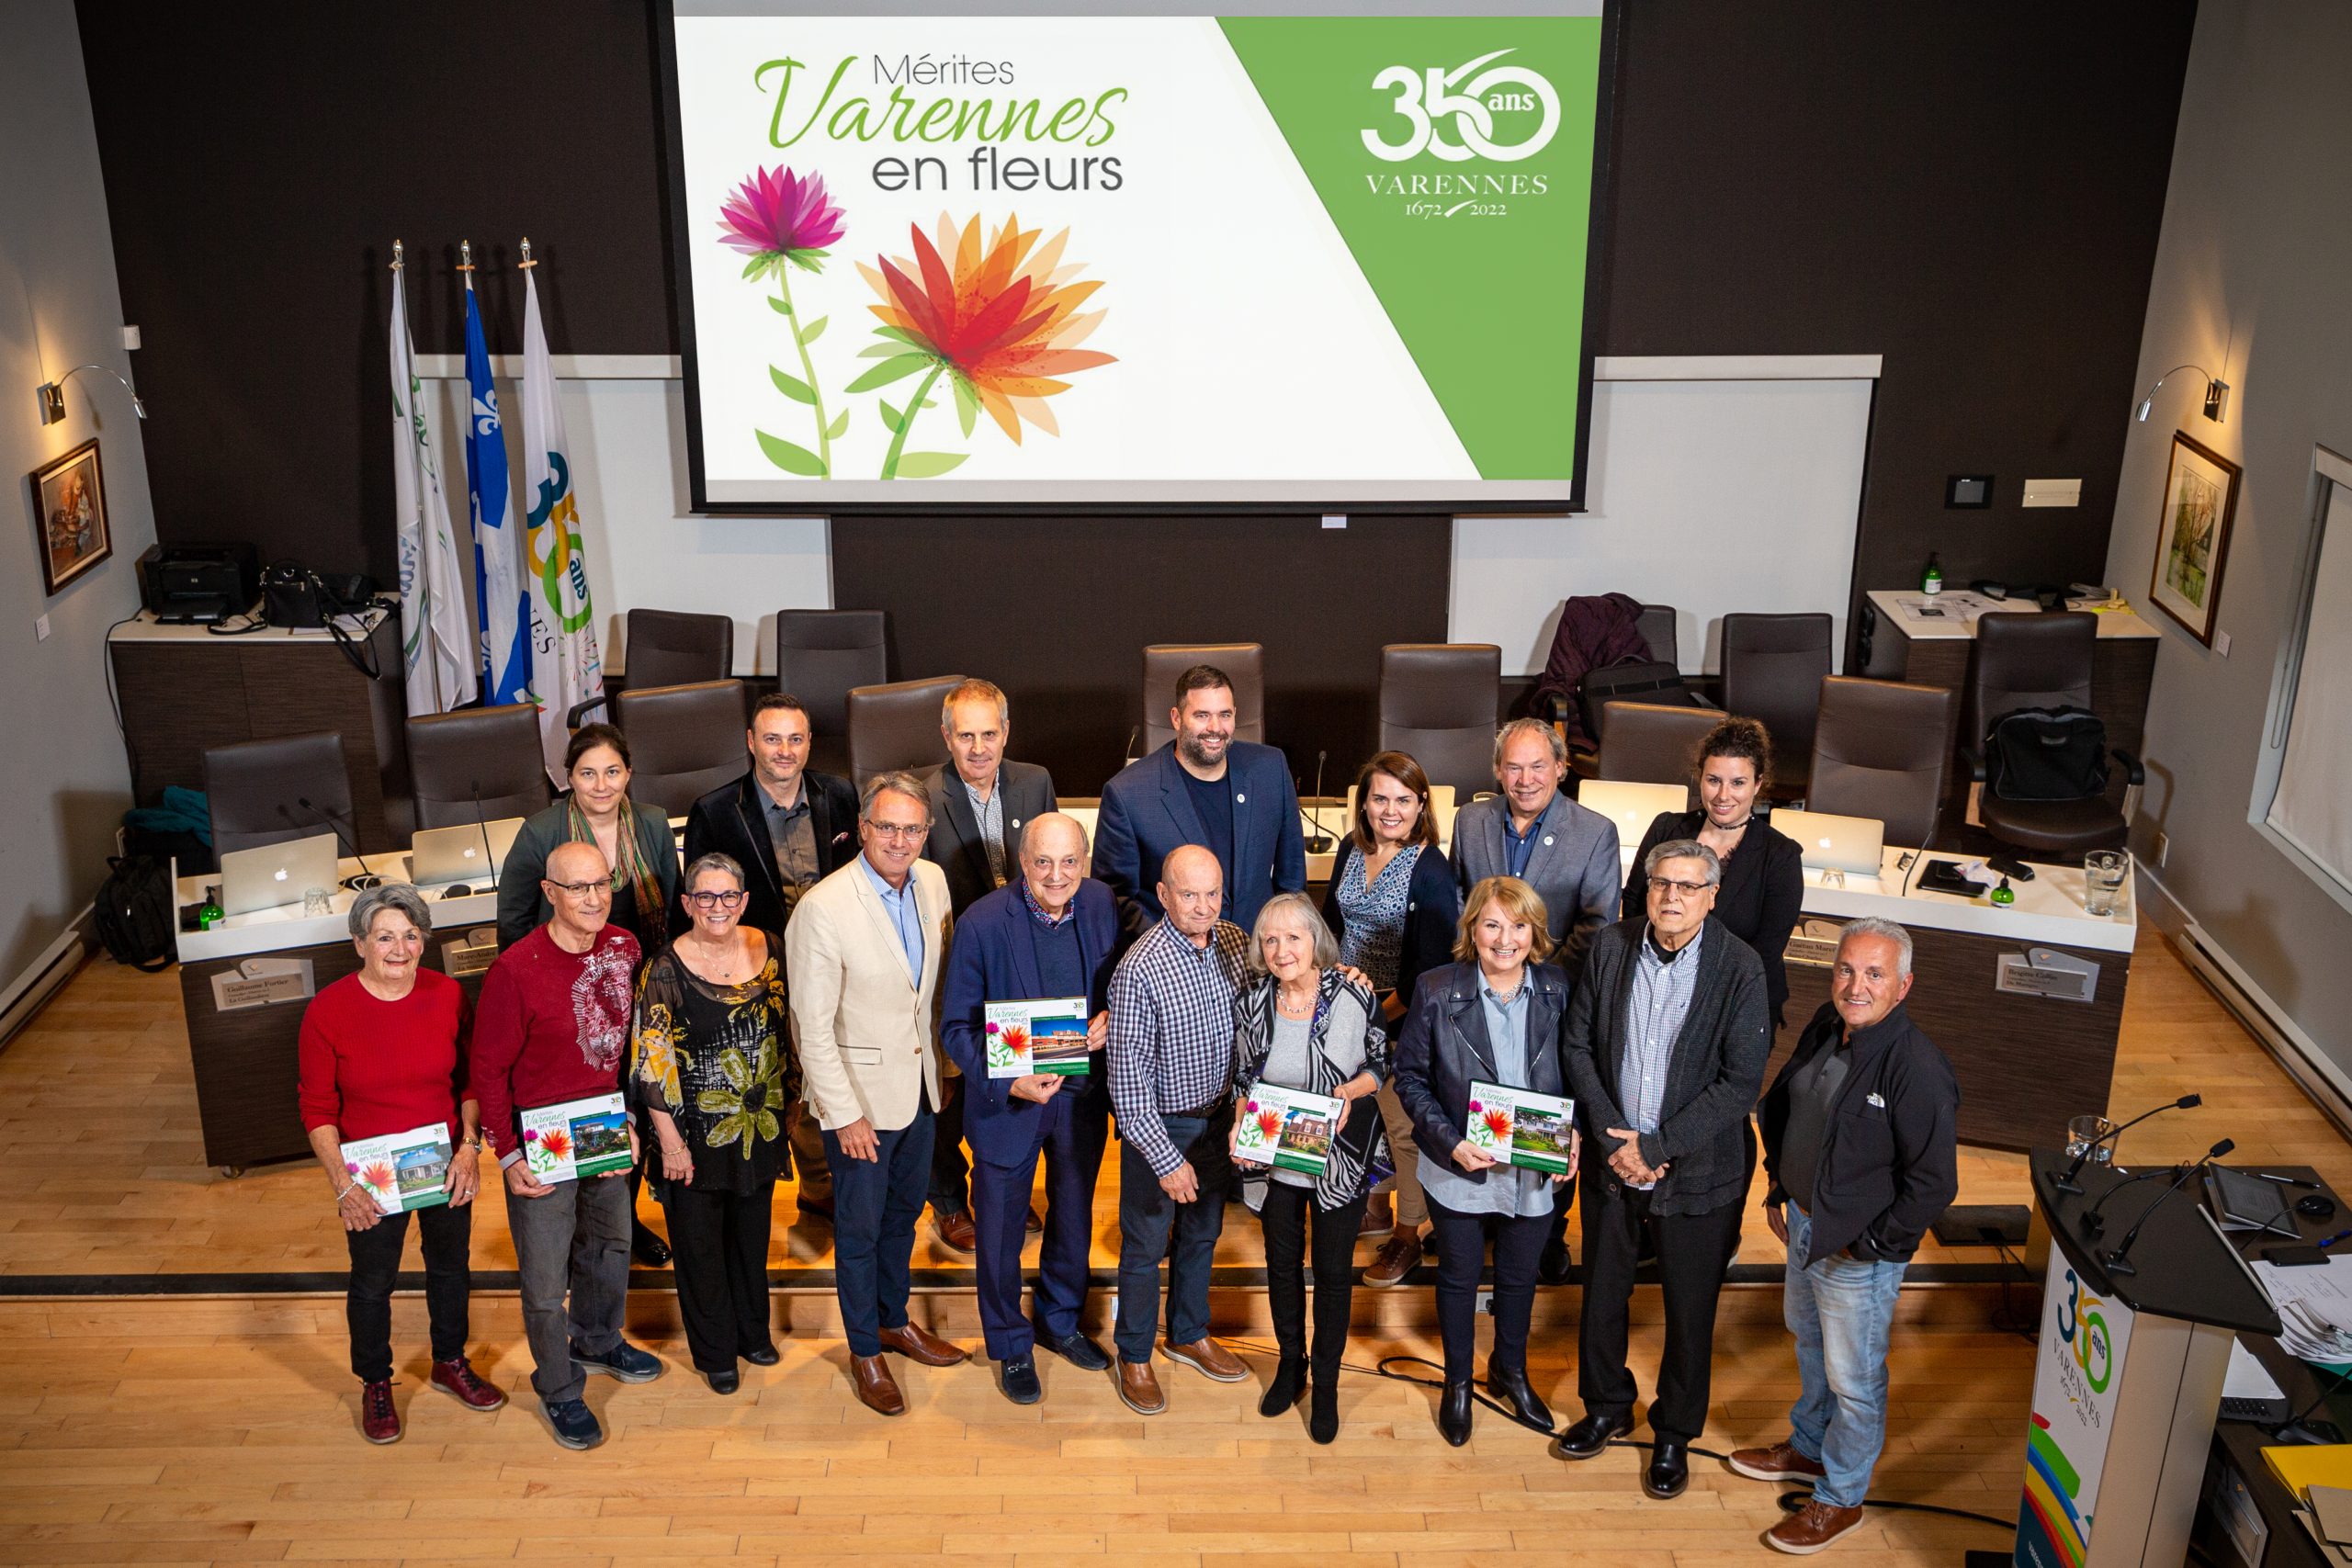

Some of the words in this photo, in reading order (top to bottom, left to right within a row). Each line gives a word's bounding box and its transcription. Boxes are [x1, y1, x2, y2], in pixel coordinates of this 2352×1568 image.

[874, 52, 1014, 85] Mérites
[754, 55, 1129, 149] Varennes
[1361, 47, 1562, 162] 350
[1487, 92, 1535, 112] ans
[871, 155, 948, 191] en
[968, 146, 1124, 191] fleurs
[1365, 175, 1548, 195] VARENNES
[1406, 199, 1442, 220] 1672
[1470, 203, 1507, 216] 2022
[569, 558, 588, 600] ans
[227, 983, 263, 992] Guillaume
[264, 979, 288, 987] Fortier
[988, 1008, 1028, 1019] Varennes
[1474, 1086, 1513, 1103] Varennes
[524, 1111, 565, 1127] Varennes
[344, 1143, 388, 1160] Varennes
[2058, 1269, 2111, 1393] 350
[2092, 1331, 2106, 1359] ans
[2053, 1337, 2100, 1428] VARENNES
[2060, 1376, 2071, 1397] 1672
[2075, 1404, 2087, 1427] 2022
